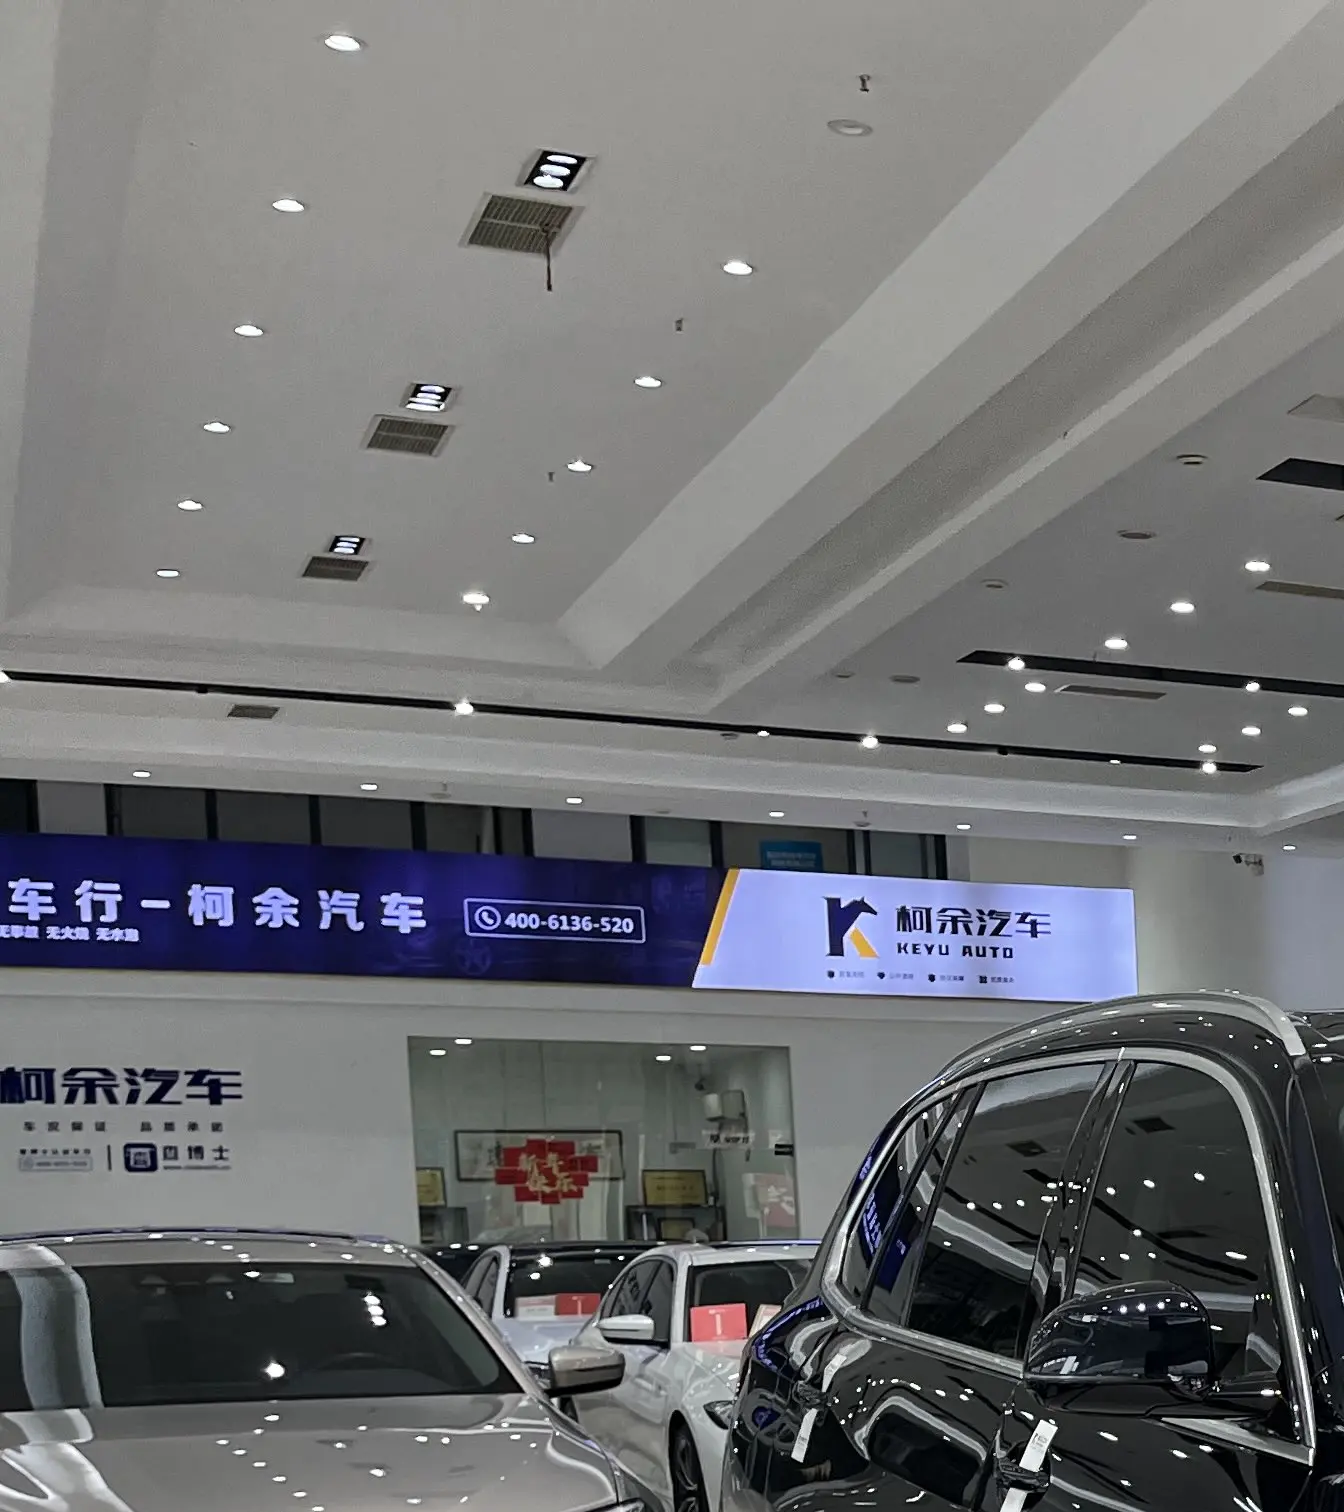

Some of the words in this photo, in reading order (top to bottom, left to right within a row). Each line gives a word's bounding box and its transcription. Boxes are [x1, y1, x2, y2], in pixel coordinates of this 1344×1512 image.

[503, 910, 635, 936] 400-6136-520
[895, 904, 1052, 939] 柯余汽车
[896, 942, 950, 956] KEYU
[961, 945, 1014, 959] AUTO
[0, 1066, 243, 1105] 柯余汽车
